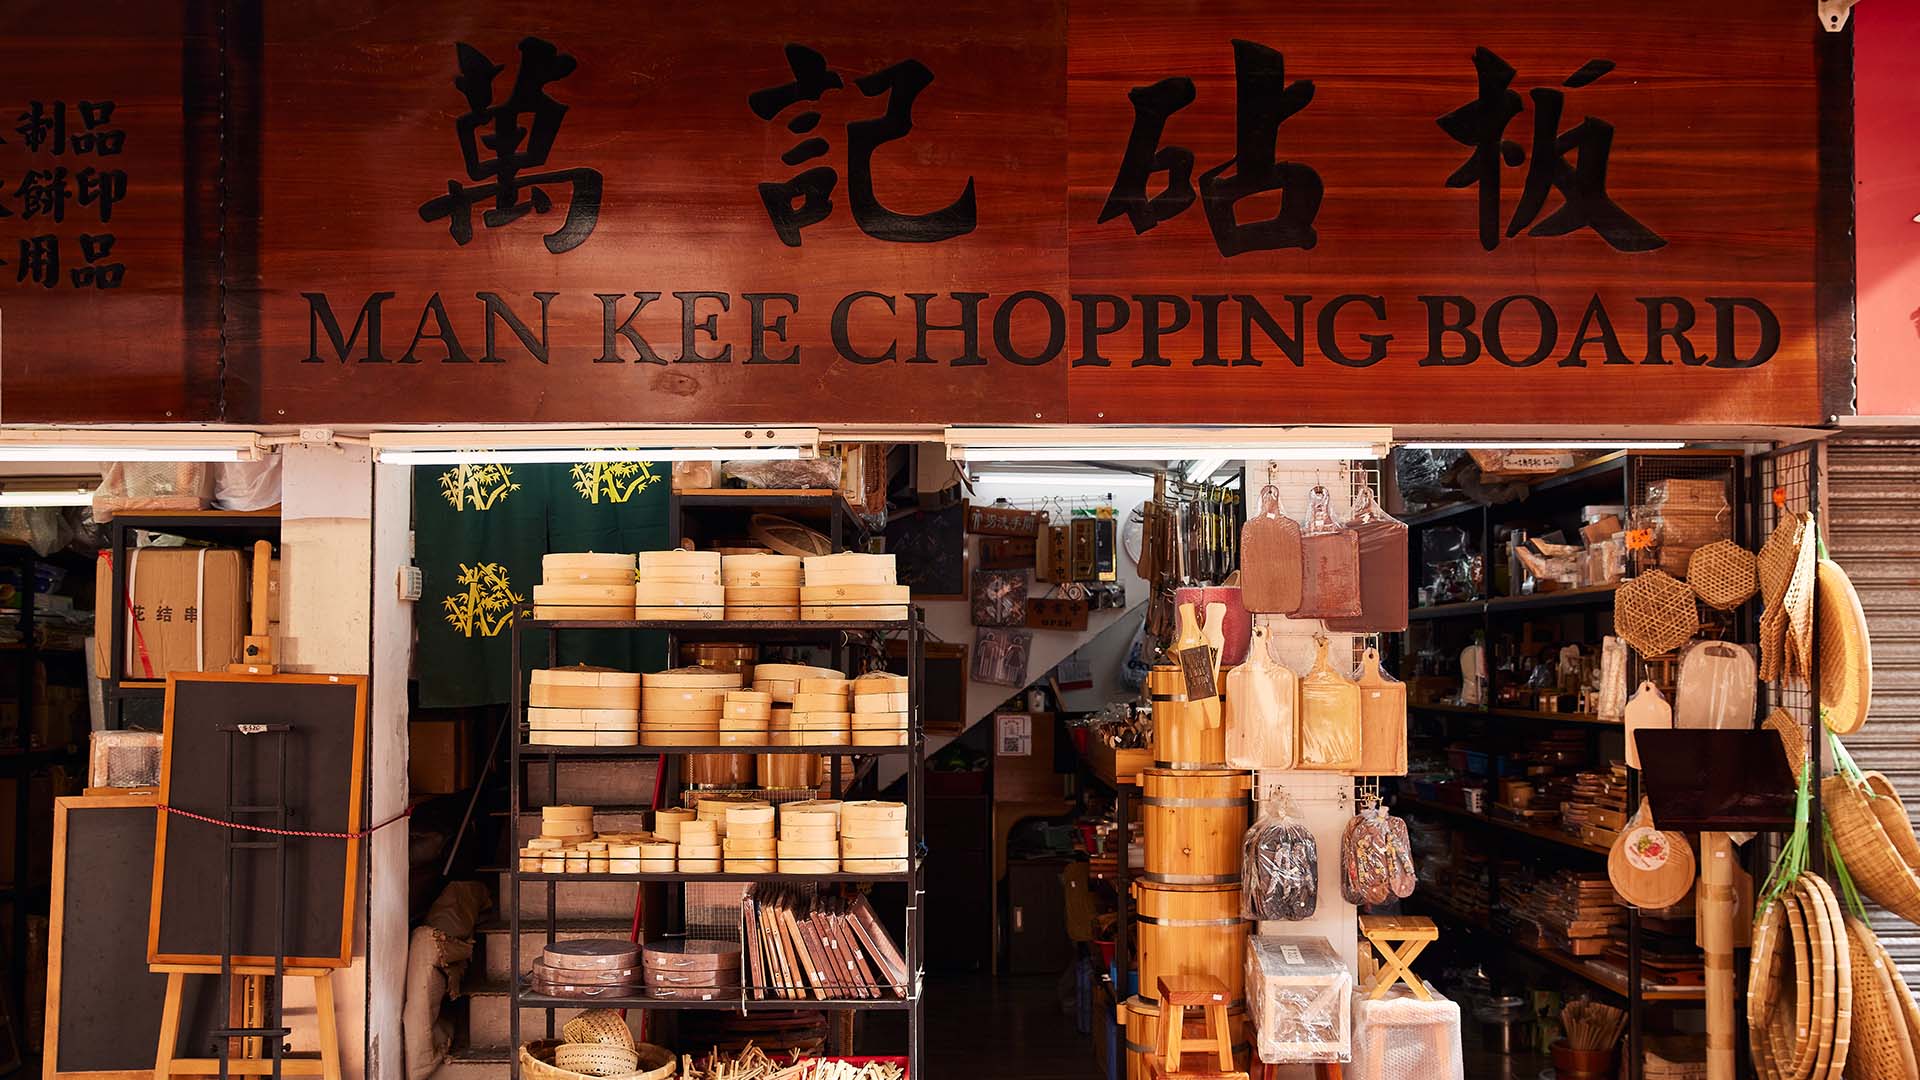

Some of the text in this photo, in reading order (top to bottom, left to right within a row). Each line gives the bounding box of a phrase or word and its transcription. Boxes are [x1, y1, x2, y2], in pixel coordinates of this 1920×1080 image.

[0, 101, 126, 156] 制品
[418, 37, 1668, 257] 萬記砧板
[0, 167, 127, 223] 餅印
[0, 234, 126, 289] 用品
[301, 290, 1780, 368] MAN KEE CHOPPING BOARD
